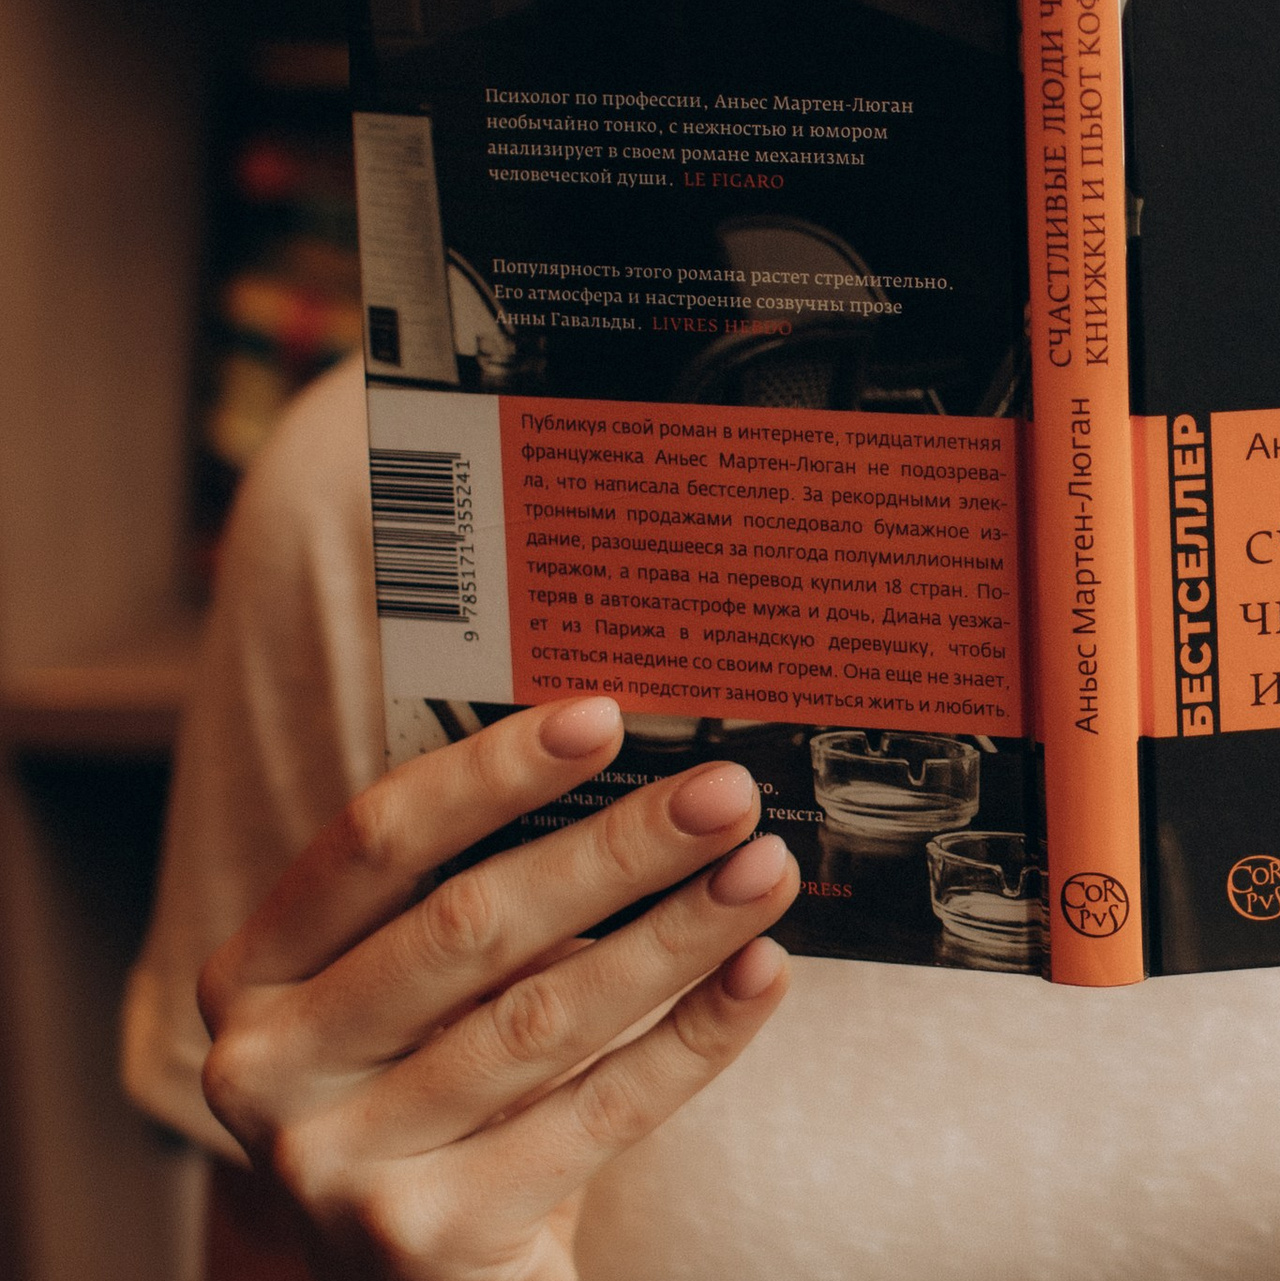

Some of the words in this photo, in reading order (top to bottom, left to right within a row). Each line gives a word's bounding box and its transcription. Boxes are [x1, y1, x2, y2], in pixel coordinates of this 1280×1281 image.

[484, 87, 571, 106] Психолог
[574, 92, 598, 107] по
[601, 89, 709, 111] профессии,
[713, 93, 769, 111] Аньес
[772, 94, 914, 116] Мартен-Люган
[1041, 29, 1070, 137] ЛЮДИ
[486, 112, 600, 133] необычайно
[603, 119, 664, 137] тонко,
[668, 120, 678, 135] с
[682, 120, 788, 138] нежностью
[791, 124, 805, 139] и
[809, 124, 889, 144] юмором
[1079, 67, 1104, 169] ПЬЮТ
[486, 141, 604, 162] анализирует
[607, 145, 619, 160] в
[621, 145, 677, 161] своем
[680, 146, 750, 165] романе
[754, 149, 866, 167] механизмы
[487, 167, 613, 185] человеческой
[616, 171, 674, 189] души.
[684, 170, 706, 188] LE
[712, 171, 785, 190] FIGARO
[1081, 178, 1106, 202] И
[492, 256, 621, 281] Популярность
[624, 265, 673, 281] этого
[676, 266, 747, 285] романа
[749, 269, 811, 288] растет
[813, 271, 954, 292] стремительно.
[1044, 145, 1072, 368] СЧАСТЛИВЫЕ
[492, 283, 525, 303] Его
[527, 286, 624, 308] атмосфера
[627, 291, 640, 306] и
[645, 292, 753, 311] настроение
[754, 295, 845, 315] созвучны
[849, 295, 903, 319] прозе
[1083, 213, 1109, 366] КНИЖКИ
[492, 308, 547, 327] Анны
[550, 310, 642, 332] Гавальды.
[652, 315, 718, 334] LIVRES
[723, 318, 794, 338] HEBDO
[520, 411, 608, 437] Публикуя
[611, 417, 655, 436] свой
[658, 421, 718, 440] роман
[722, 425, 733, 441] в
[737, 425, 840, 448] интернете,
[844, 430, 1002, 452] тридцатилетняя
[520, 441, 645, 466] француженка
[653, 448, 708, 468] Аньес
[718, 451, 857, 476] Мартен-Люган
[867, 461, 890, 478] не
[900, 462, 1006, 485] подозрева-
[456, 460, 473, 533] 355241
[523, 473, 549, 491] ла,
[556, 475, 588, 492] что
[593, 477, 681, 497] написала
[686, 478, 795, 505] бестселлер.
[802, 485, 824, 504] За
[830, 489, 951, 510] рекордными
[958, 495, 1007, 512] элек-
[1068, 397, 1102, 635] Мартен-Люган
[525, 531, 586, 550] дание,
[590, 534, 725, 557] разошедшееся
[729, 542, 748, 558] за
[752, 543, 829, 564] полгода
[834, 548, 1004, 572] полумиллионным
[460, 543, 477, 616] 785171
[526, 559, 612, 581] тиражом,
[619, 565, 630, 581] а
[636, 566, 691, 585] права
[697, 570, 720, 585] на
[726, 571, 804, 592] перевод
[810, 576, 878, 595] купили
[884, 577, 903, 596] 18
[909, 581, 968, 601] стран.
[976, 581, 1009, 601] По-
[1173, 413, 1214, 737] БЕСТСЕЛЛЕР
[527, 587, 579, 608] теряв
[583, 591, 595, 607] в
[599, 593, 747, 618] автокатастрофе
[752, 601, 802, 621] мужа
[807, 605, 820, 620] и
[825, 606, 875, 625] дочь,
[881, 605, 942, 628] Диана
[947, 612, 1010, 632] уезжа-
[464, 630, 479, 642] 9
[529, 616, 548, 632] ет
[561, 619, 582, 635] из
[594, 618, 666, 640] Парижа
[679, 625, 690, 642] в
[702, 628, 816, 651] ирландскую
[827, 635, 934, 659] деревушку,
[947, 640, 1006, 660] чтобы
[530, 645, 609, 663] остаться
[612, 650, 689, 670] наедине
[691, 657, 714, 672] со
[716, 657, 774, 675] своим
[777, 660, 838, 680] горем.
[842, 661, 882, 682] Она
[884, 667, 923, 686] еще
[926, 670, 950, 686] не
[953, 671, 1010, 691] знает,
[1074, 643, 1099, 735] Аньес
[766, 807, 826, 823] текста
